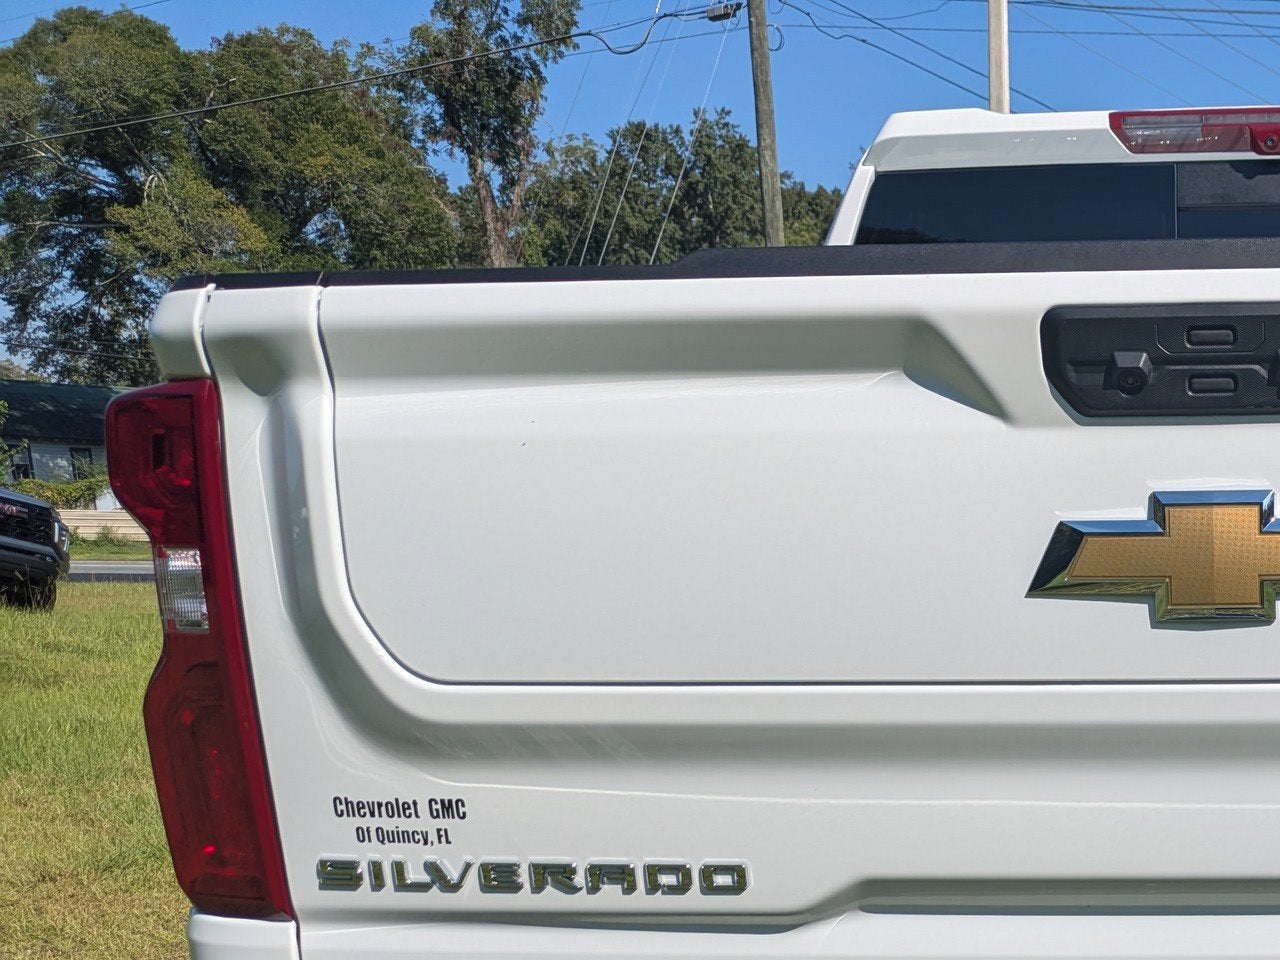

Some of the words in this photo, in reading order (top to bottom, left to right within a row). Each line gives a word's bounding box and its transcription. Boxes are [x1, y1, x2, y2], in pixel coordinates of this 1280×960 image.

[332, 796, 421, 819] Chevrolet
[428, 798, 467, 820] GMC
[355, 826, 372, 843] Of
[375, 826, 434, 847] Quincy,
[436, 827, 452, 845] FL
[317, 858, 750, 895] SILVERADO
